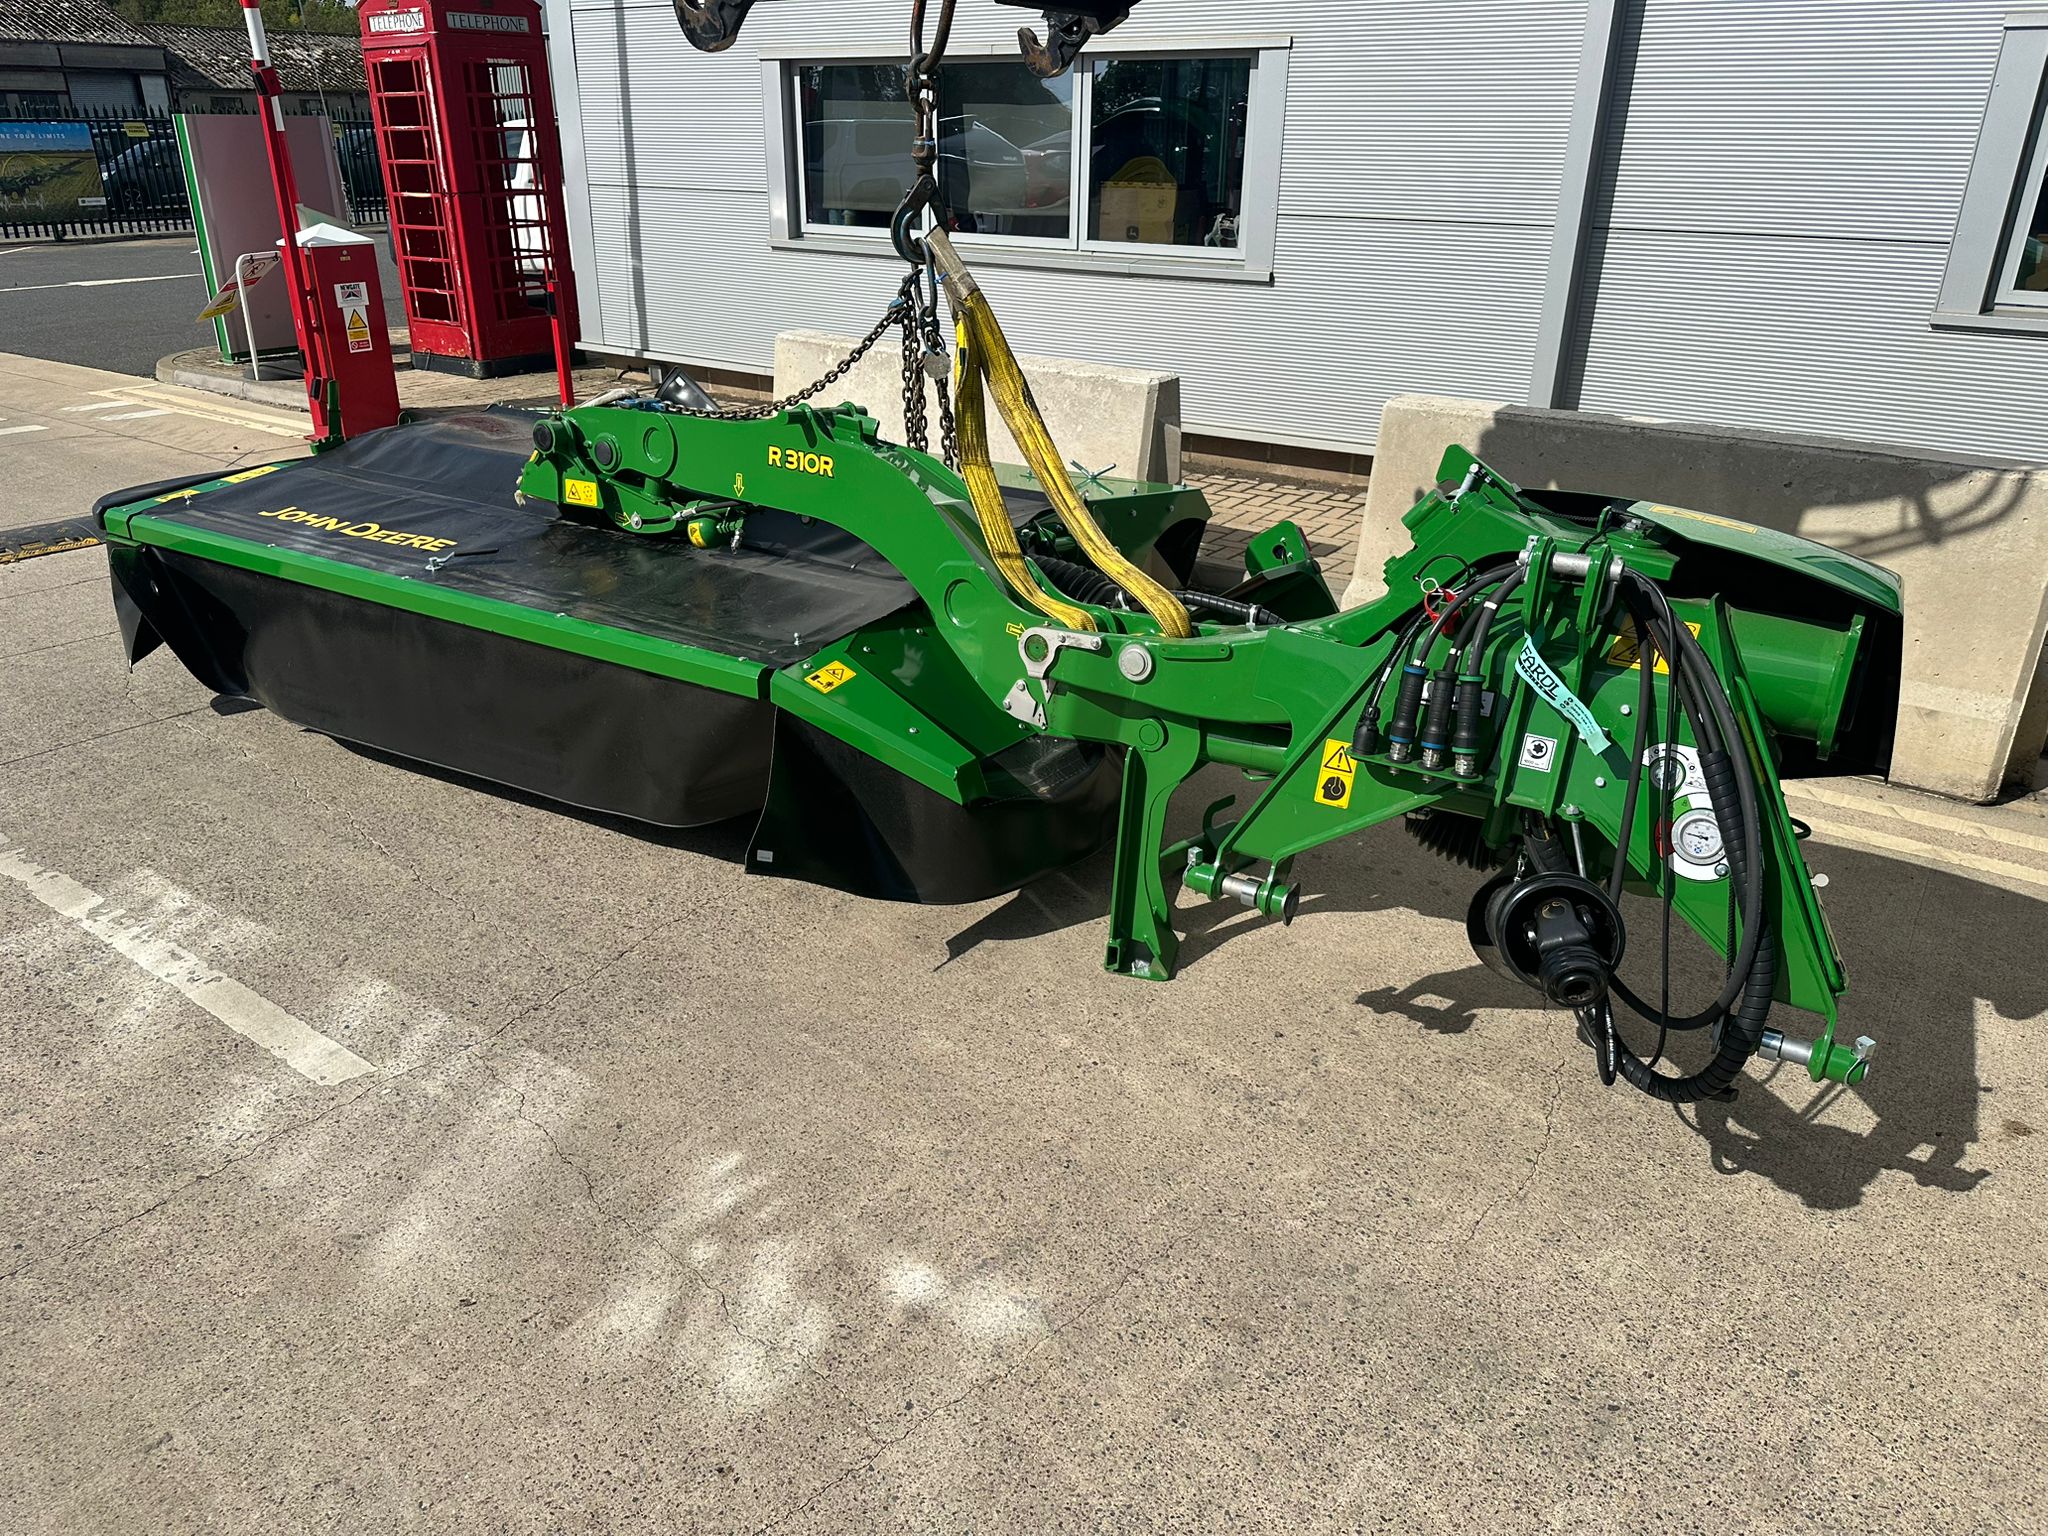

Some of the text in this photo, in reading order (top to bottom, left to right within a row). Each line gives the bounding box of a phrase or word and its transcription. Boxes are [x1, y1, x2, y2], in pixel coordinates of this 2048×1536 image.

[372, 13, 424, 30] TELEPHONE
[450, 14, 525, 32] TELEPHONE
[768, 445, 782, 468] R
[258, 506, 458, 553] JOHN DEERE
